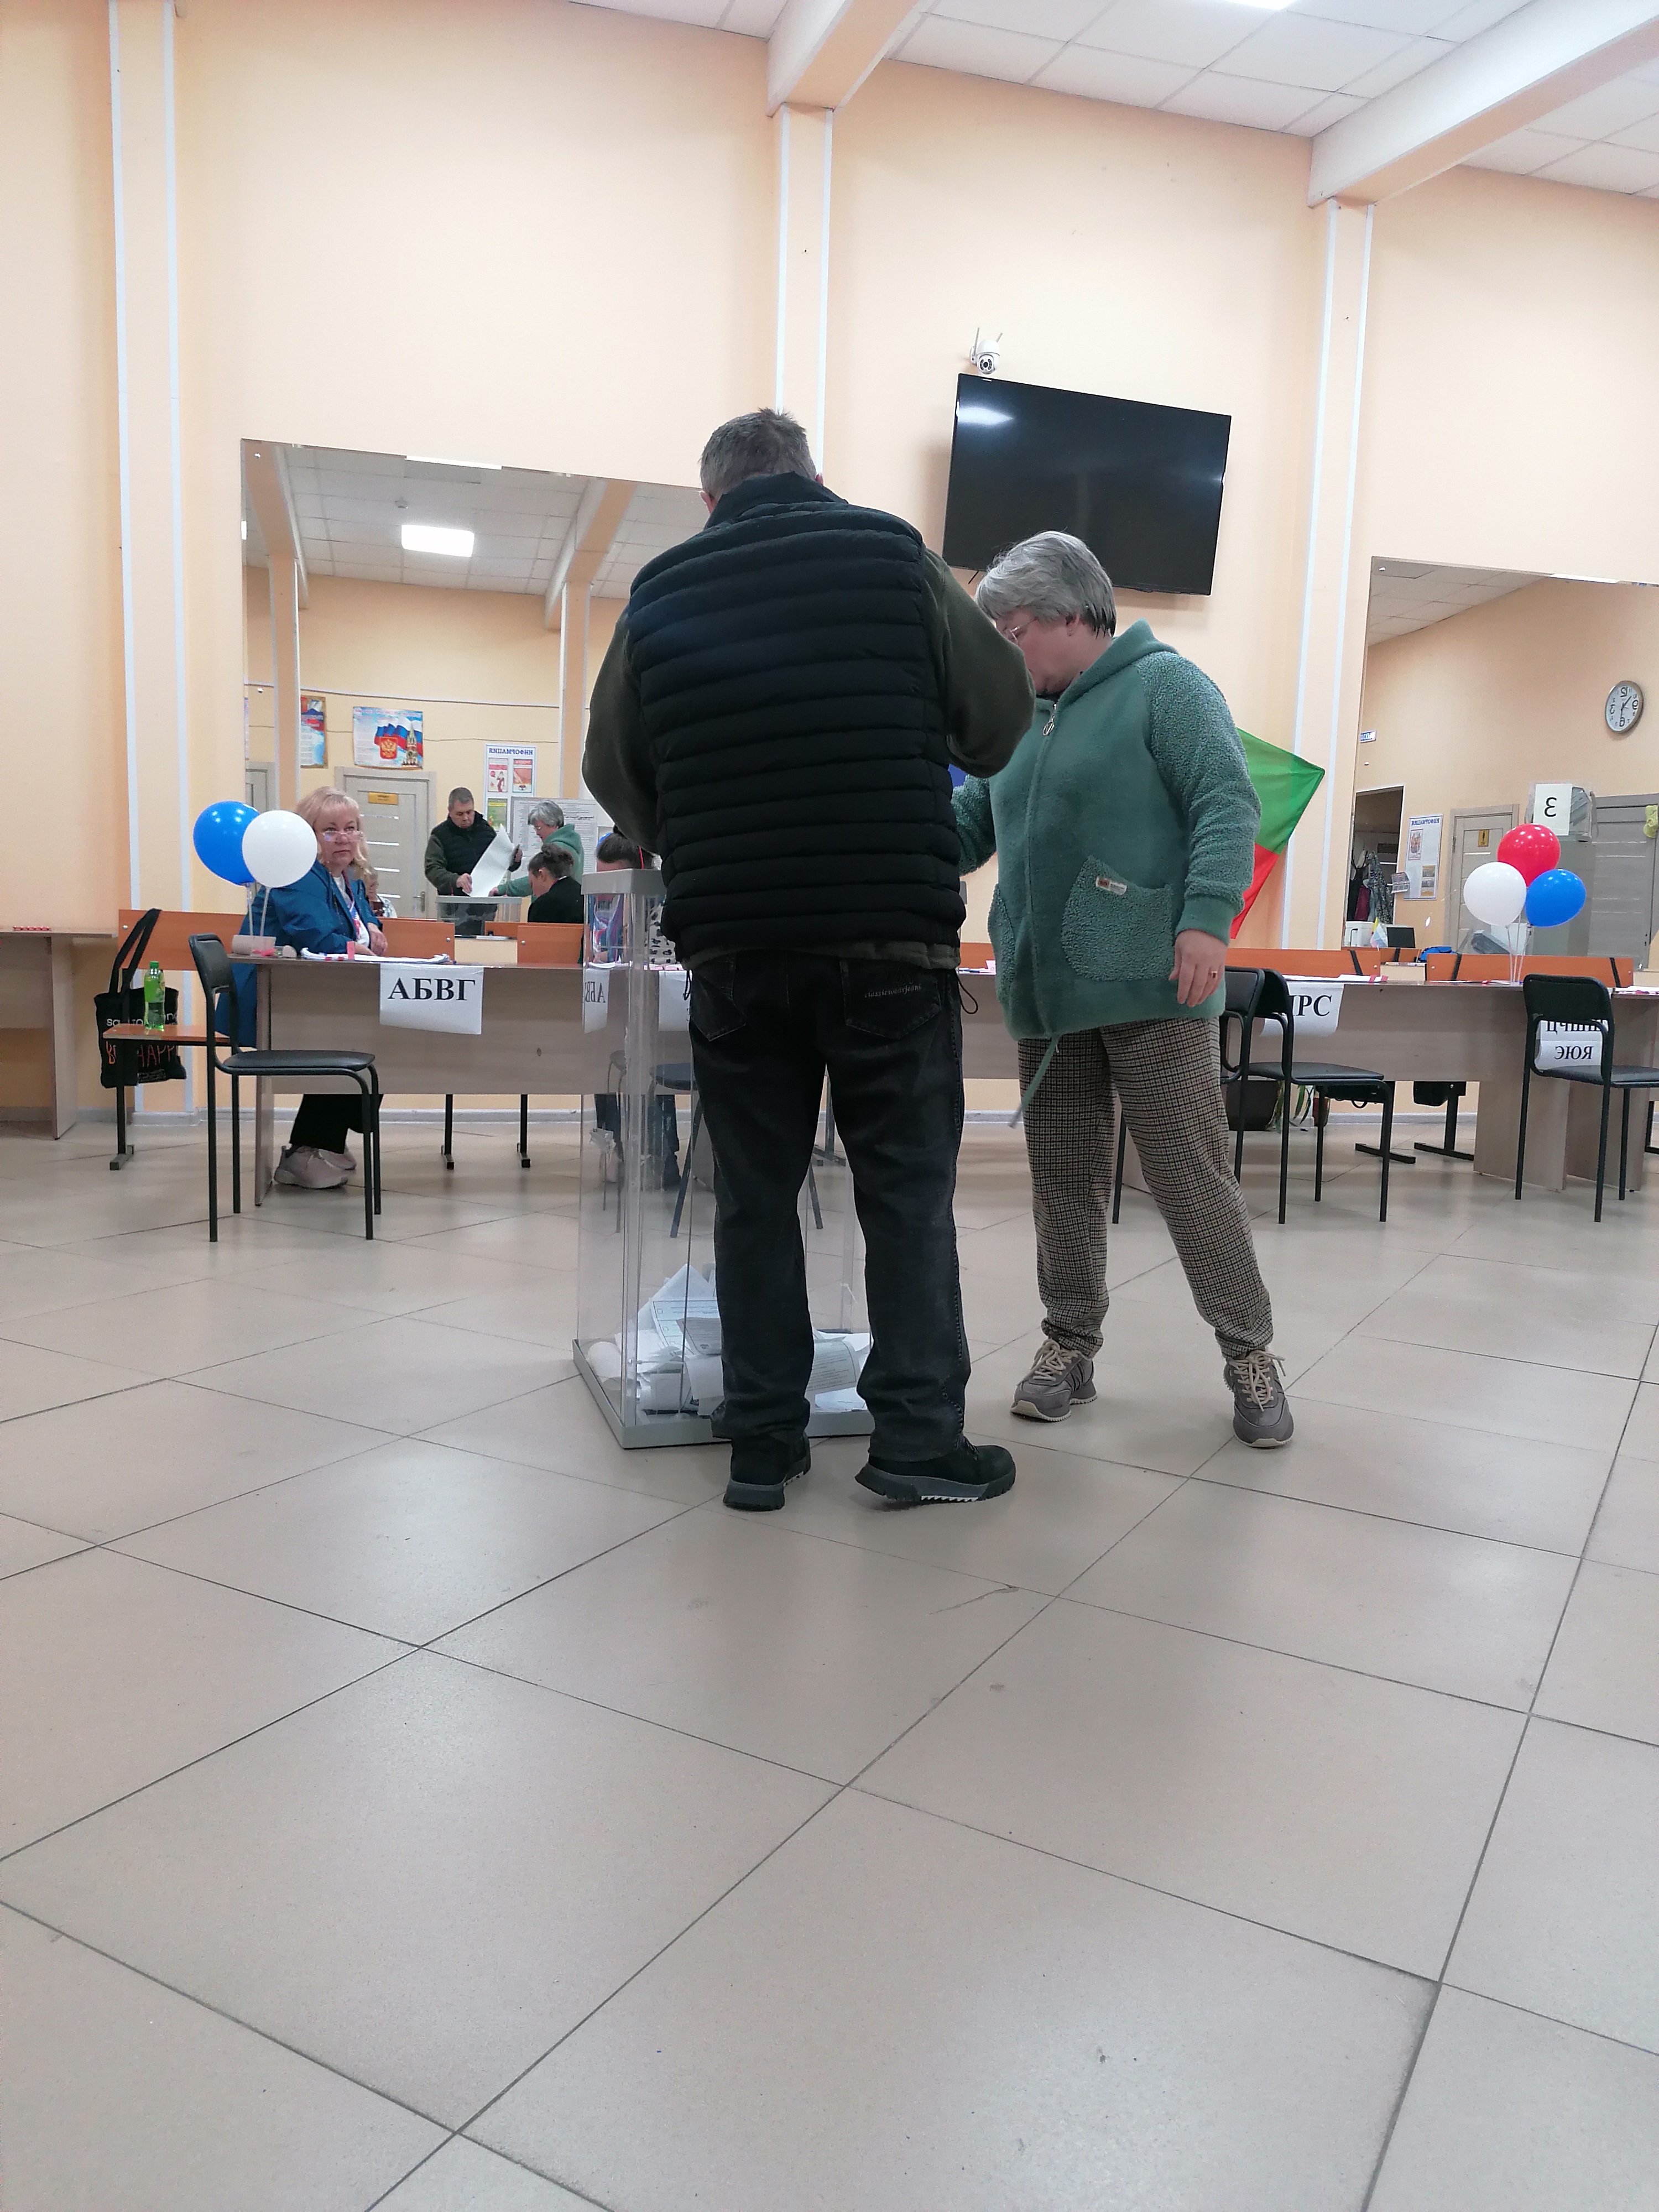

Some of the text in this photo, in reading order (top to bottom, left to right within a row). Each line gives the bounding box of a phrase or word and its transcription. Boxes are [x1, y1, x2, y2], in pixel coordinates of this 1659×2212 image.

[387, 977, 476, 1001] АБВГ
[1289, 995, 1332, 1016] РС
[138, 1044, 178, 1068] HAPP
[1554, 1046, 1594, 1060] ЭЮЯ
